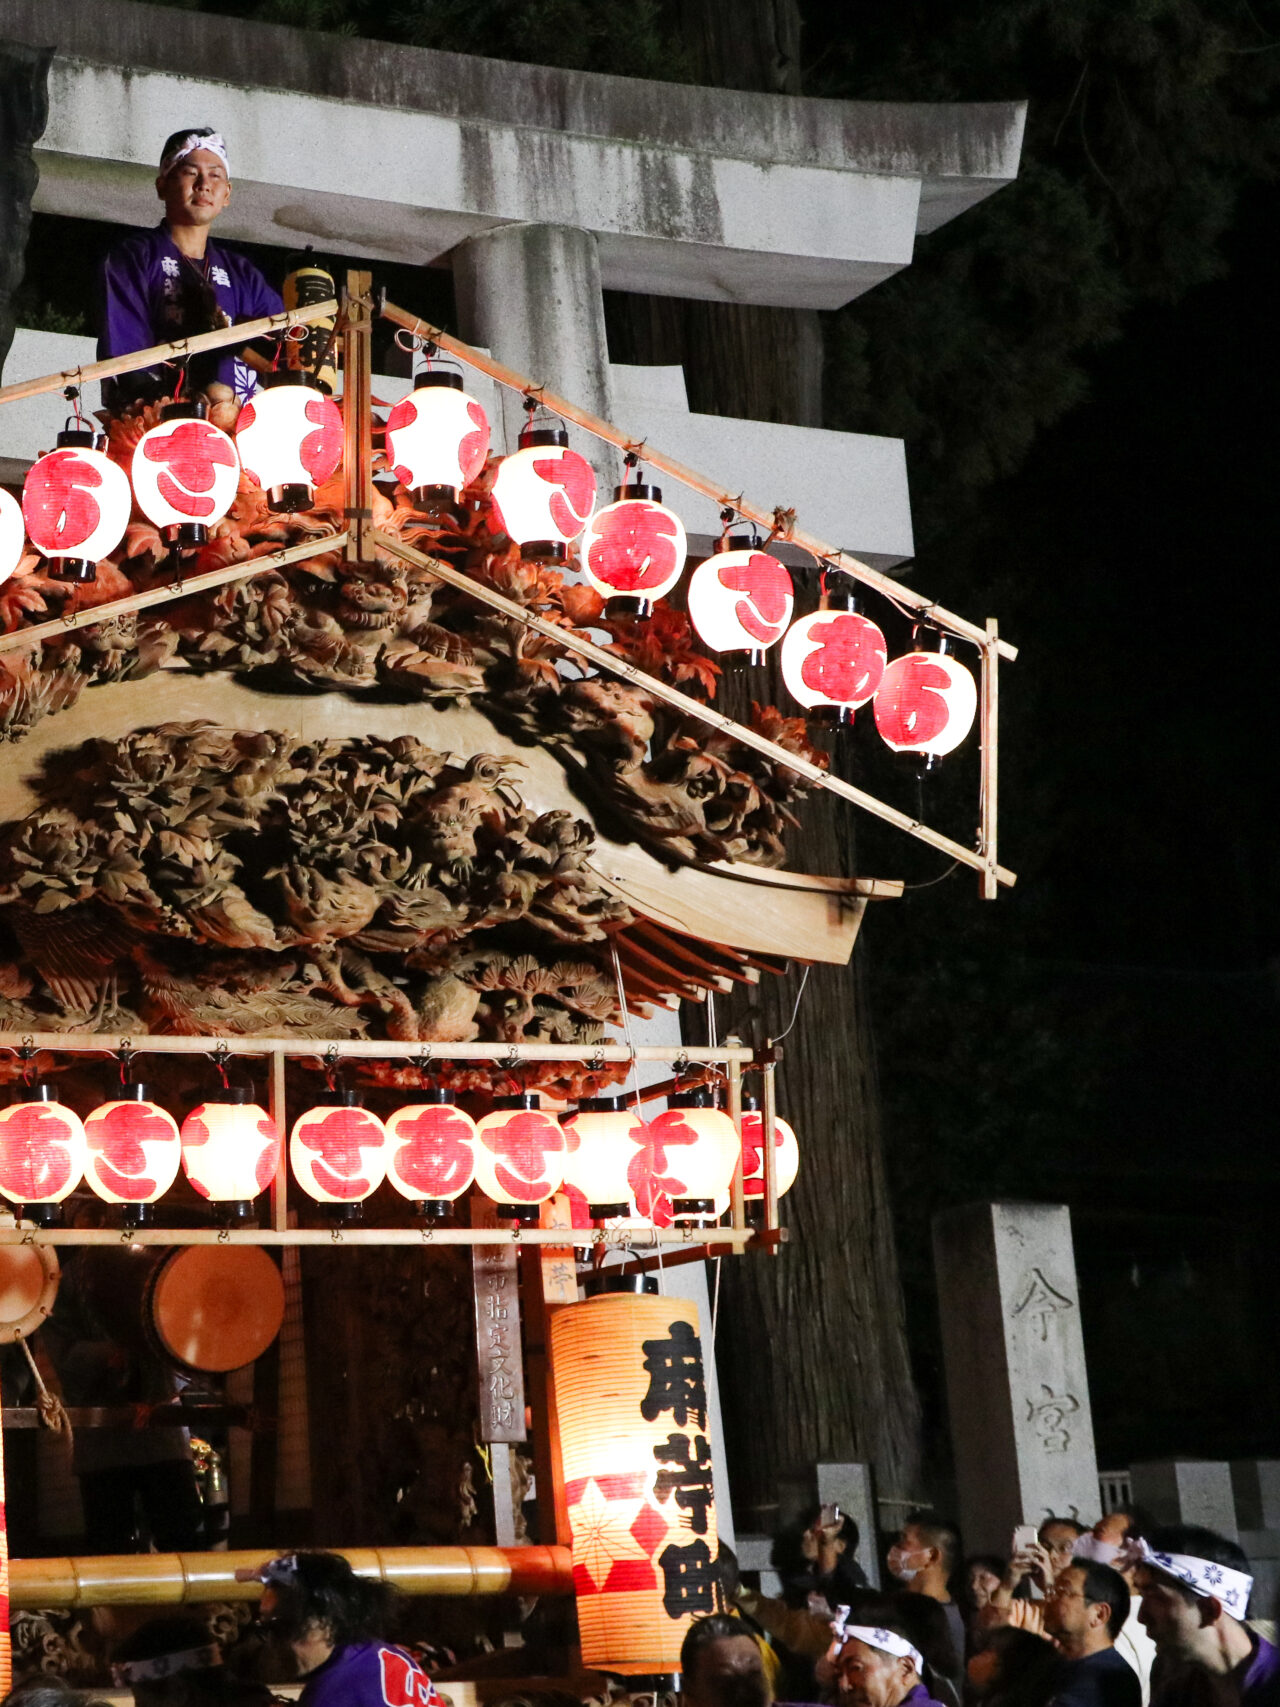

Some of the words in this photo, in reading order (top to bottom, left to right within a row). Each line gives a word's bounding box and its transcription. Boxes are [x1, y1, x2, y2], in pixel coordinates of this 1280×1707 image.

[143, 422, 236, 516] さ
[85, 1104, 176, 1197] さ
[299, 1110, 385, 1197] さ
[481, 1112, 565, 1200] さ
[1012, 1267, 1080, 1521] 今宮
